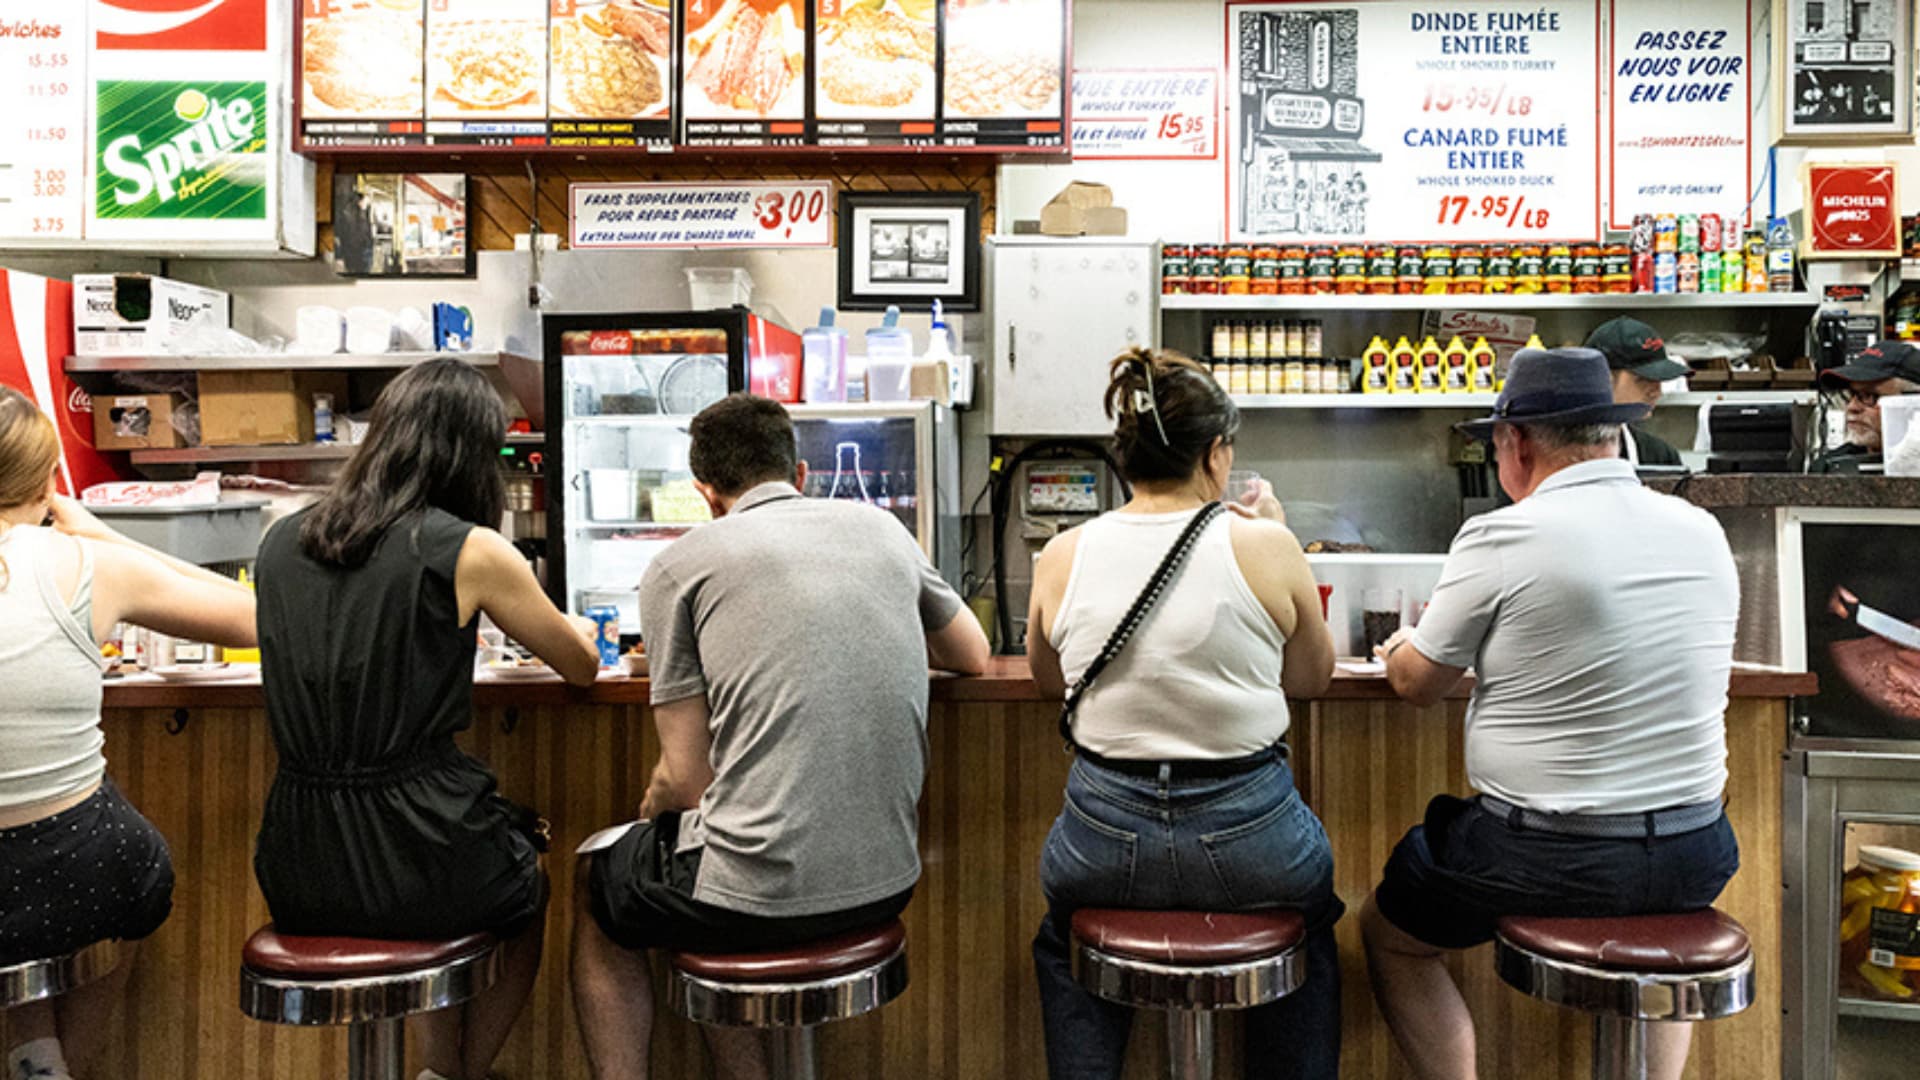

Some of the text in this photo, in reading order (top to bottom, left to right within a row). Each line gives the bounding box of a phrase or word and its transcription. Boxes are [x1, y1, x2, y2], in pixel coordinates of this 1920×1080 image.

[556, 0, 568, 13] 3
[691, 0, 703, 14] 4
[822, 1, 835, 14] 5
[1411, 8, 1561, 31] DINDE FUMÉE
[1441, 32, 1530, 54] ENTIÈRE
[1636, 31, 1728, 50] PASSEZ
[1416, 60, 1556, 71] WHOLE SMOKED TURKEY
[1618, 56, 1744, 77] NOUS VOIR
[1629, 82, 1734, 102] EN LIGNE
[1404, 124, 1568, 147] CANARD FUMÉ
[103, 92, 256, 206] Sprite
[1447, 151, 1525, 169] ENTIER
[34, 170, 66, 183] 3.00
[1417, 176, 1555, 186] WHOLE SMOKED DUCK
[33, 183, 66, 197] 3.00
[584, 193, 623, 206] FRAIS
[1823, 195, 1887, 208] MICHELIN
[597, 208, 634, 222] POUR
[636, 208, 680, 221] REPAS
[1437, 195, 1551, 229] 17.95/LB
[32, 217, 65, 233] 3.75
[580, 231, 615, 242] EXTRA
[659, 231, 681, 241] PER
